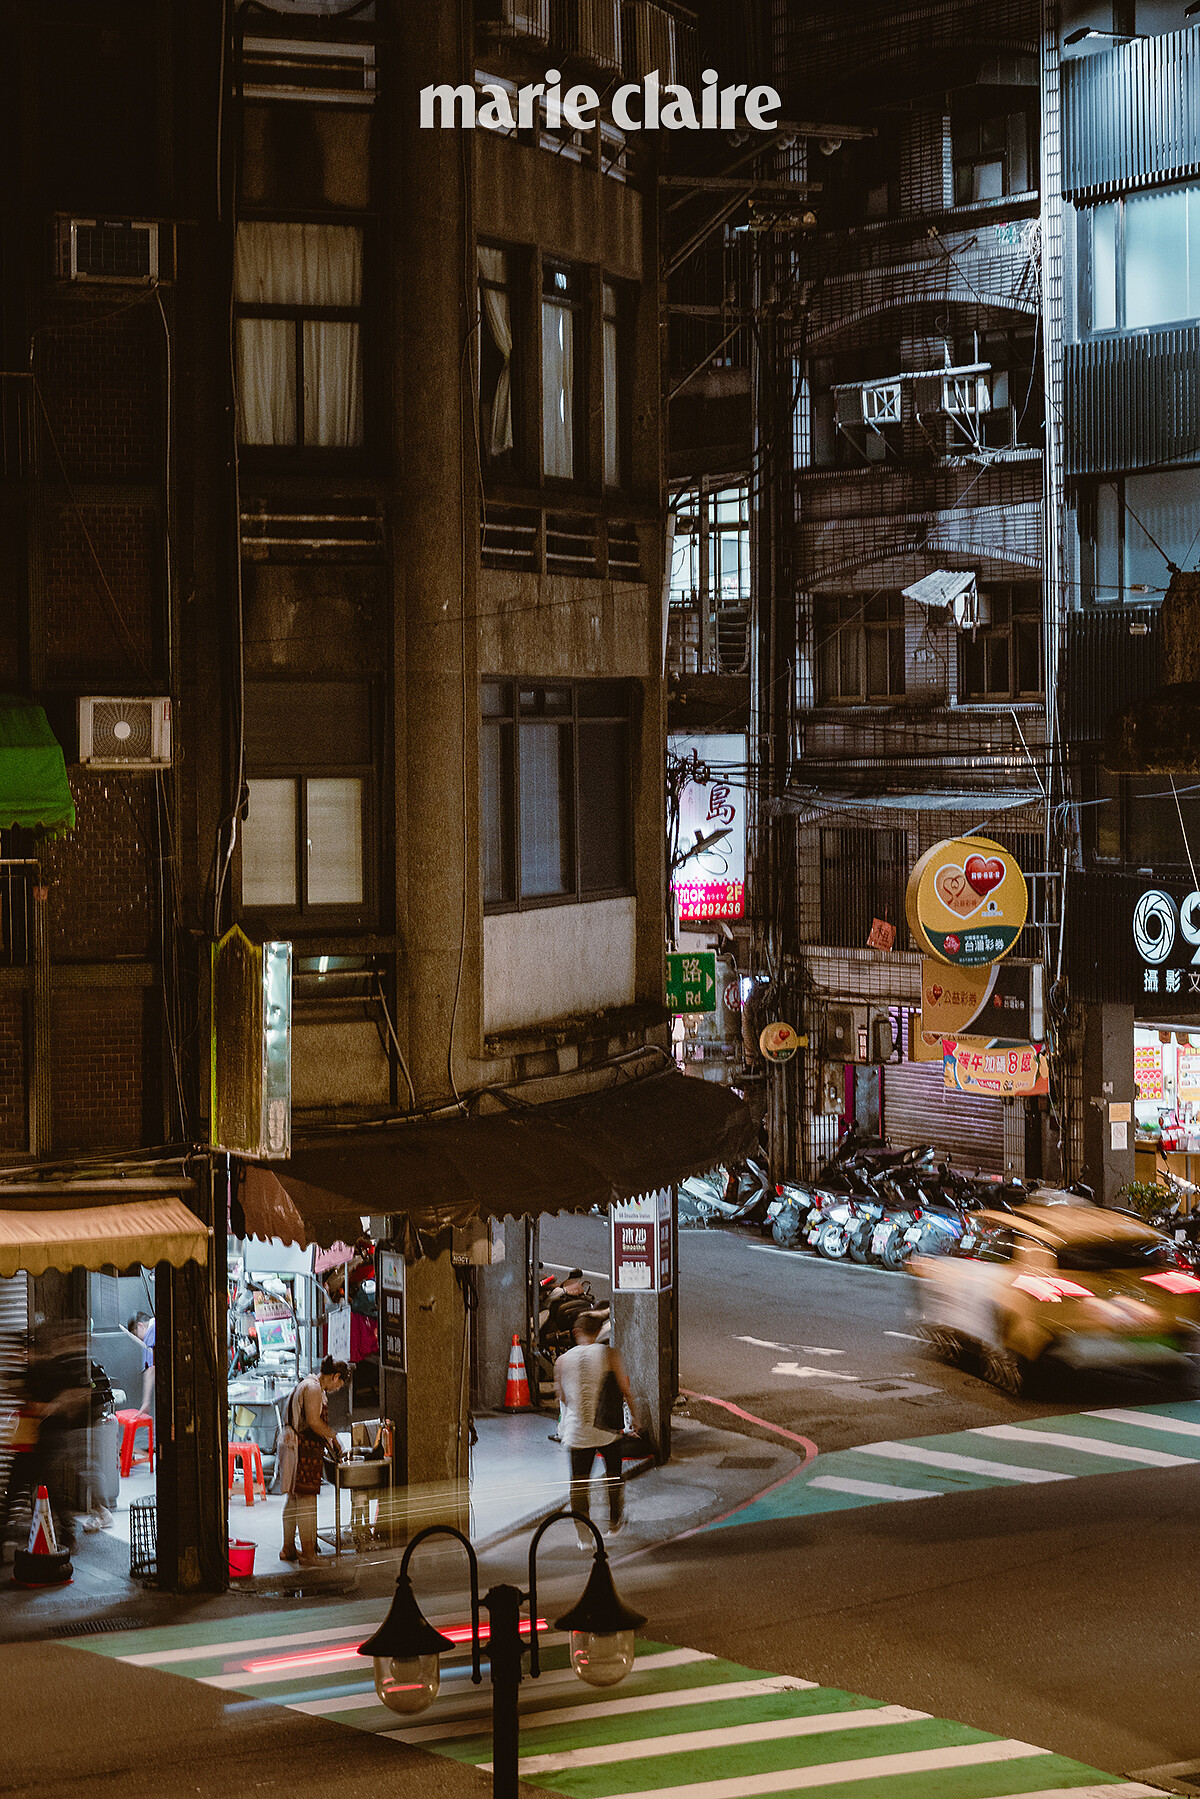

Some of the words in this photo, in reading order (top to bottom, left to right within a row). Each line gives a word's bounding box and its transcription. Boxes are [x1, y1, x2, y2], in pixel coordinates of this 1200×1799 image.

[726, 885, 743, 901] 2F
[943, 989, 977, 1007] 公益彩券
